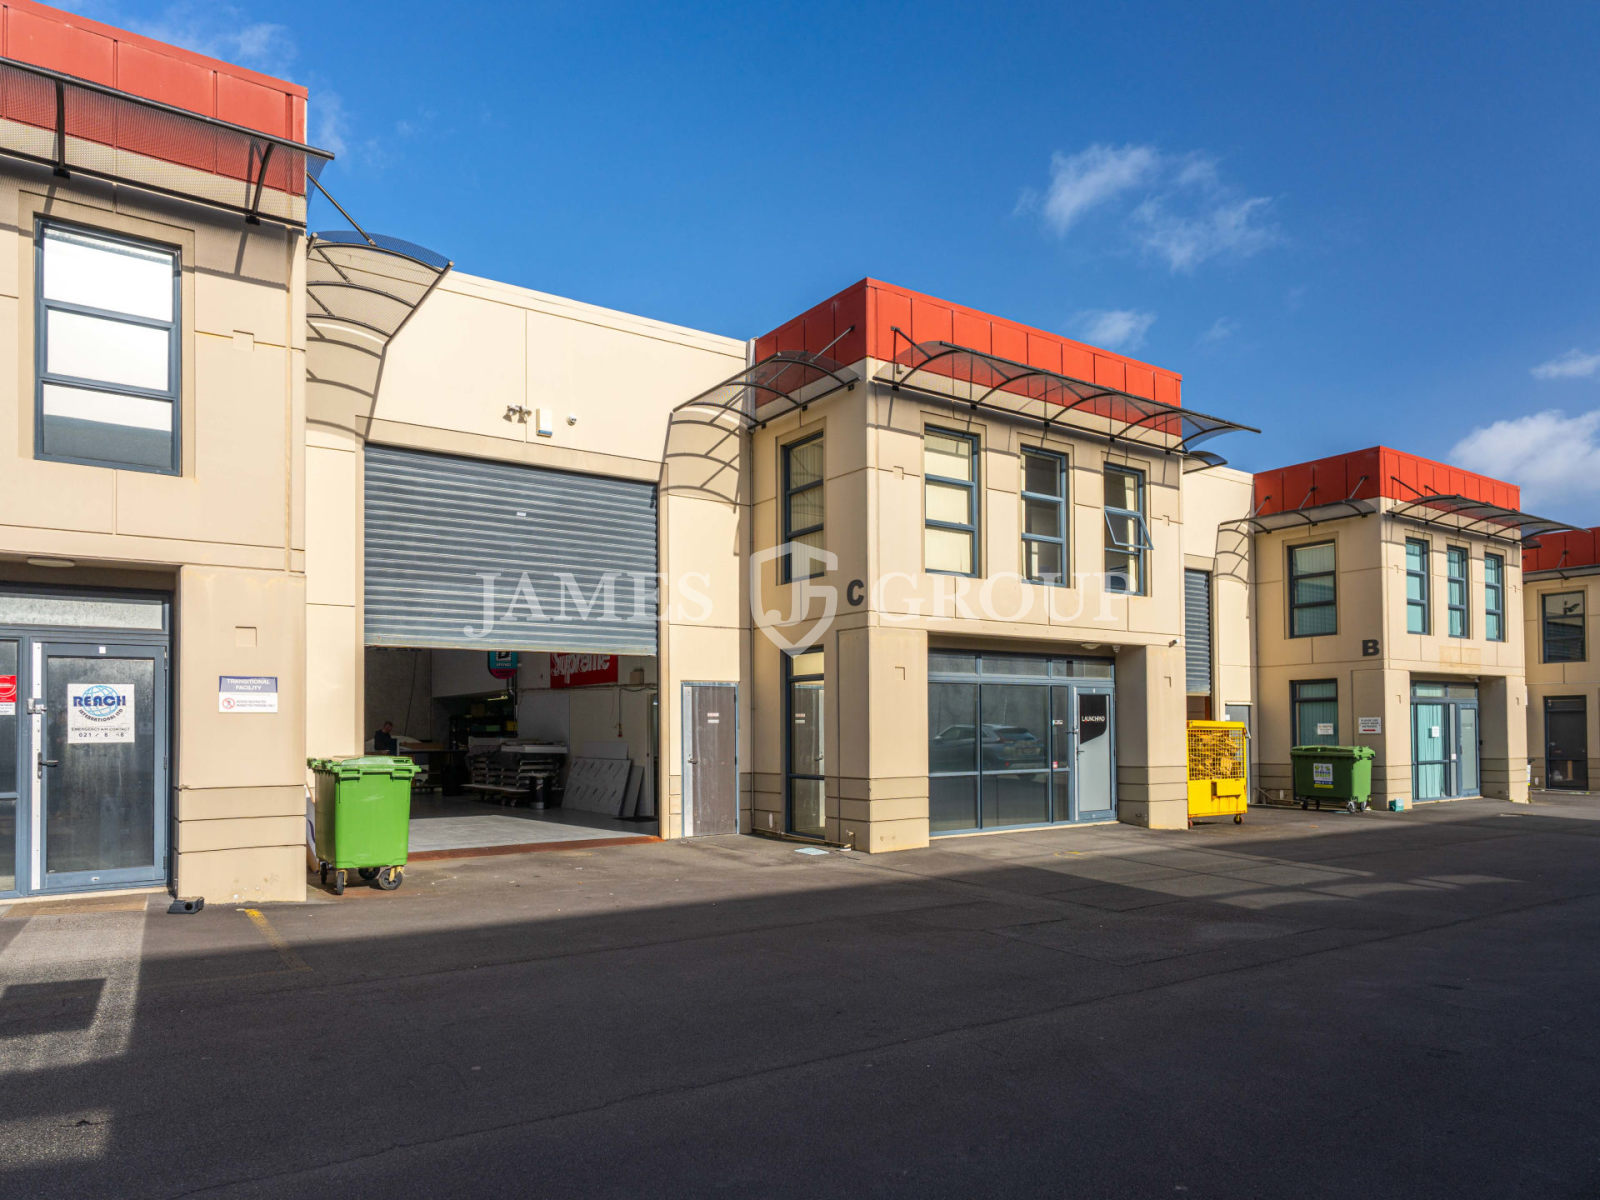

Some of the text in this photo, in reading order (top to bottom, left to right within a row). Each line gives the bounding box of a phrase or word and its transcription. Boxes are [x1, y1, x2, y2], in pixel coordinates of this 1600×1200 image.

[846, 579, 865, 606] C
[1361, 639, 1380, 657] B
[73, 695, 126, 707] REACH
